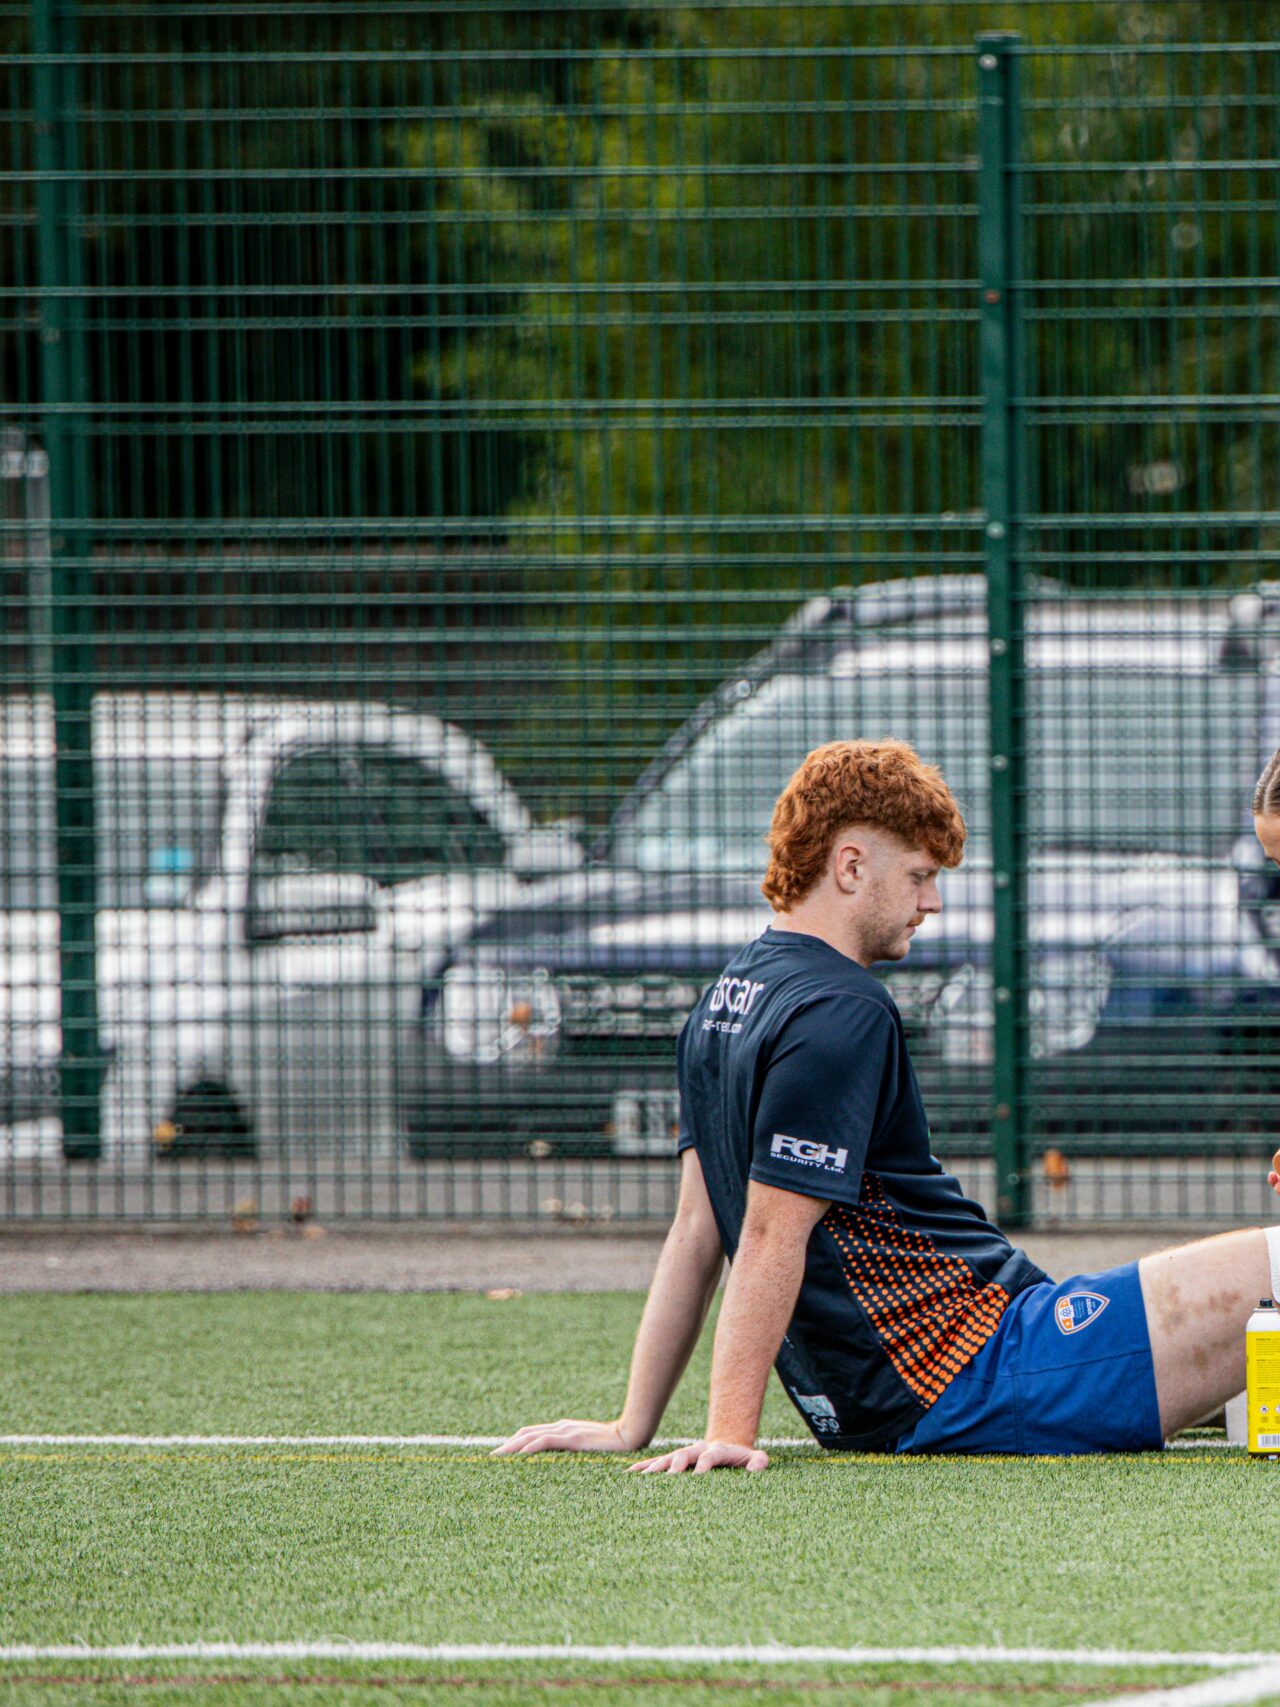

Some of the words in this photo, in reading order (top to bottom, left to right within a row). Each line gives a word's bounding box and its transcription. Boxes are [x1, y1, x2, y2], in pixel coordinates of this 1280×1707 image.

[770, 1133, 849, 1168] FGH
[770, 1152, 822, 1168] SECURITY
[824, 1164, 845, 1174] Ltd.
